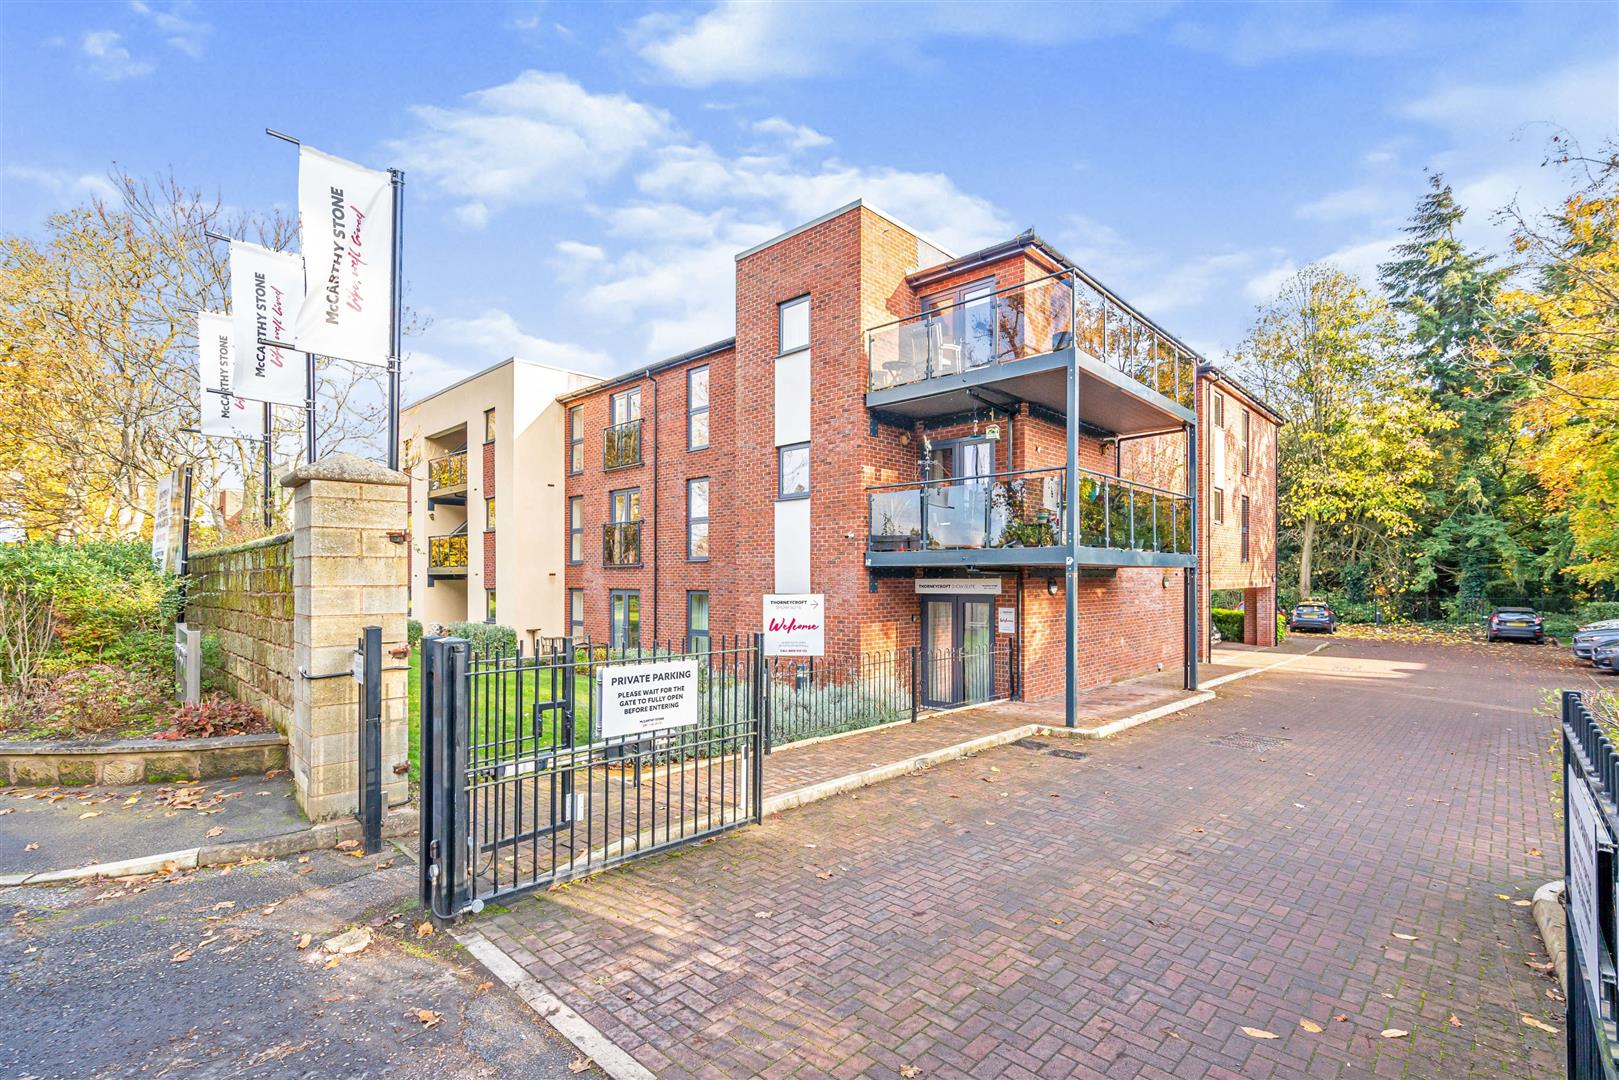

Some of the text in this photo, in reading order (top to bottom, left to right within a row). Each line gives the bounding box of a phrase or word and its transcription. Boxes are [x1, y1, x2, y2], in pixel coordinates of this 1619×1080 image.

[326, 186, 346, 325] McCARTHY STONE
[255, 271, 267, 312] STONE
[219, 335, 229, 366] STONE
[769, 617, 820, 634] Welcome
[611, 670, 691, 686] PRIVATE PARKING
[617, 690, 641, 699] PLEASE
[642, 688, 660, 696] WAIT
[660, 686, 672, 694] FOR
[619, 699, 636, 707] GATE
[647, 695, 666, 704] FULLY
[666, 693, 684, 701] OPEN
[624, 702, 679, 715] BEFORE ENTERING
